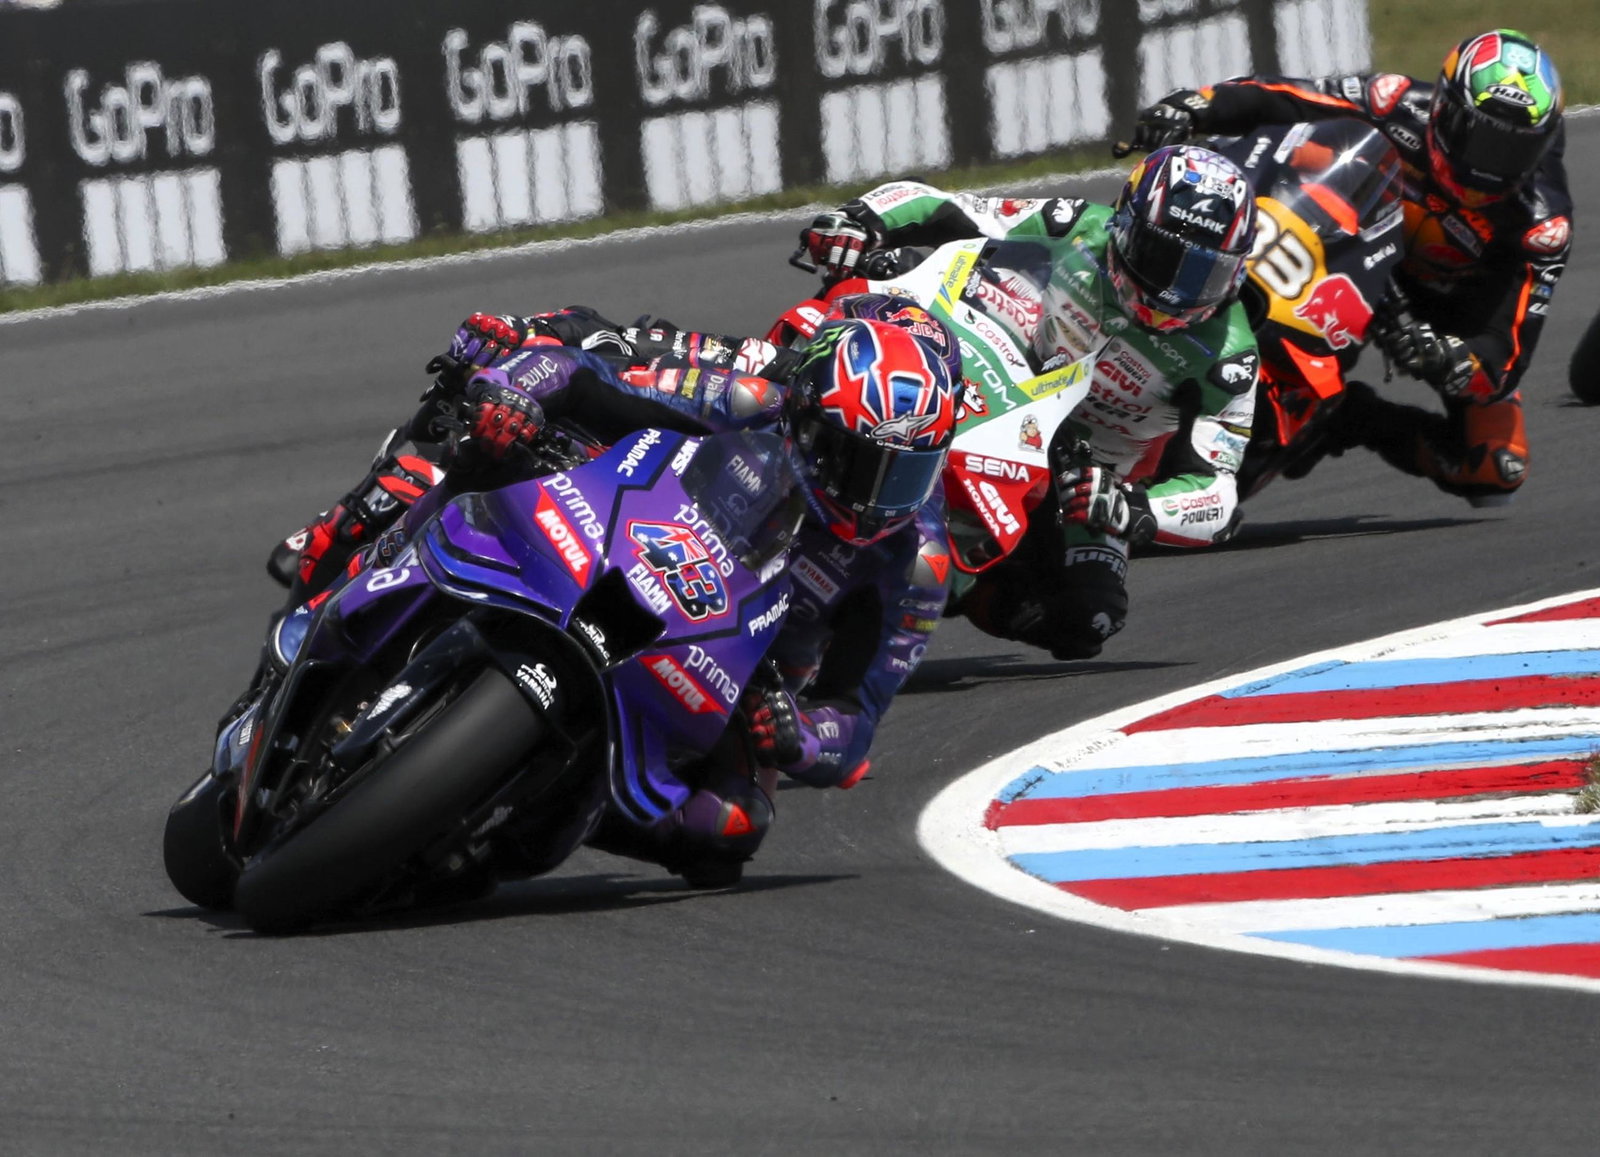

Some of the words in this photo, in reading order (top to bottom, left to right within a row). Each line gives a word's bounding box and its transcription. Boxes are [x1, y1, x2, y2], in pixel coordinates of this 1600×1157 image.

[635, 4, 776, 105] GoPro
[815, 0, 945, 78] GoPro
[257, 40, 401, 146] GoPro
[443, 20, 594, 123] GoPro
[64, 62, 216, 166] GoPro
[1169, 205, 1226, 235] SHARK
[946, 255, 967, 289] ultimate
[975, 321, 1025, 368] Castrol
[1120, 350, 1152, 379] Castrol
[959, 336, 1018, 411] STOM
[1031, 373, 1069, 397] ultimate
[1090, 381, 1153, 415] strol
[616, 427, 662, 478] PRAMAC
[965, 455, 1030, 483] SENA
[543, 472, 604, 539] prima
[963, 478, 1001, 537] HONDA
[1180, 505, 1224, 527] POWER1
[1181, 493, 1222, 512] Castrol
[536, 509, 590, 573] MOTUL
[673, 504, 735, 577] prima
[627, 563, 673, 616] FIAMM
[628, 519, 732, 622] 43
[747, 594, 790, 637] PRAMAC
[515, 667, 550, 710] YAMAHA
[651, 658, 707, 710] MOTUL
[682, 644, 740, 705] prima
